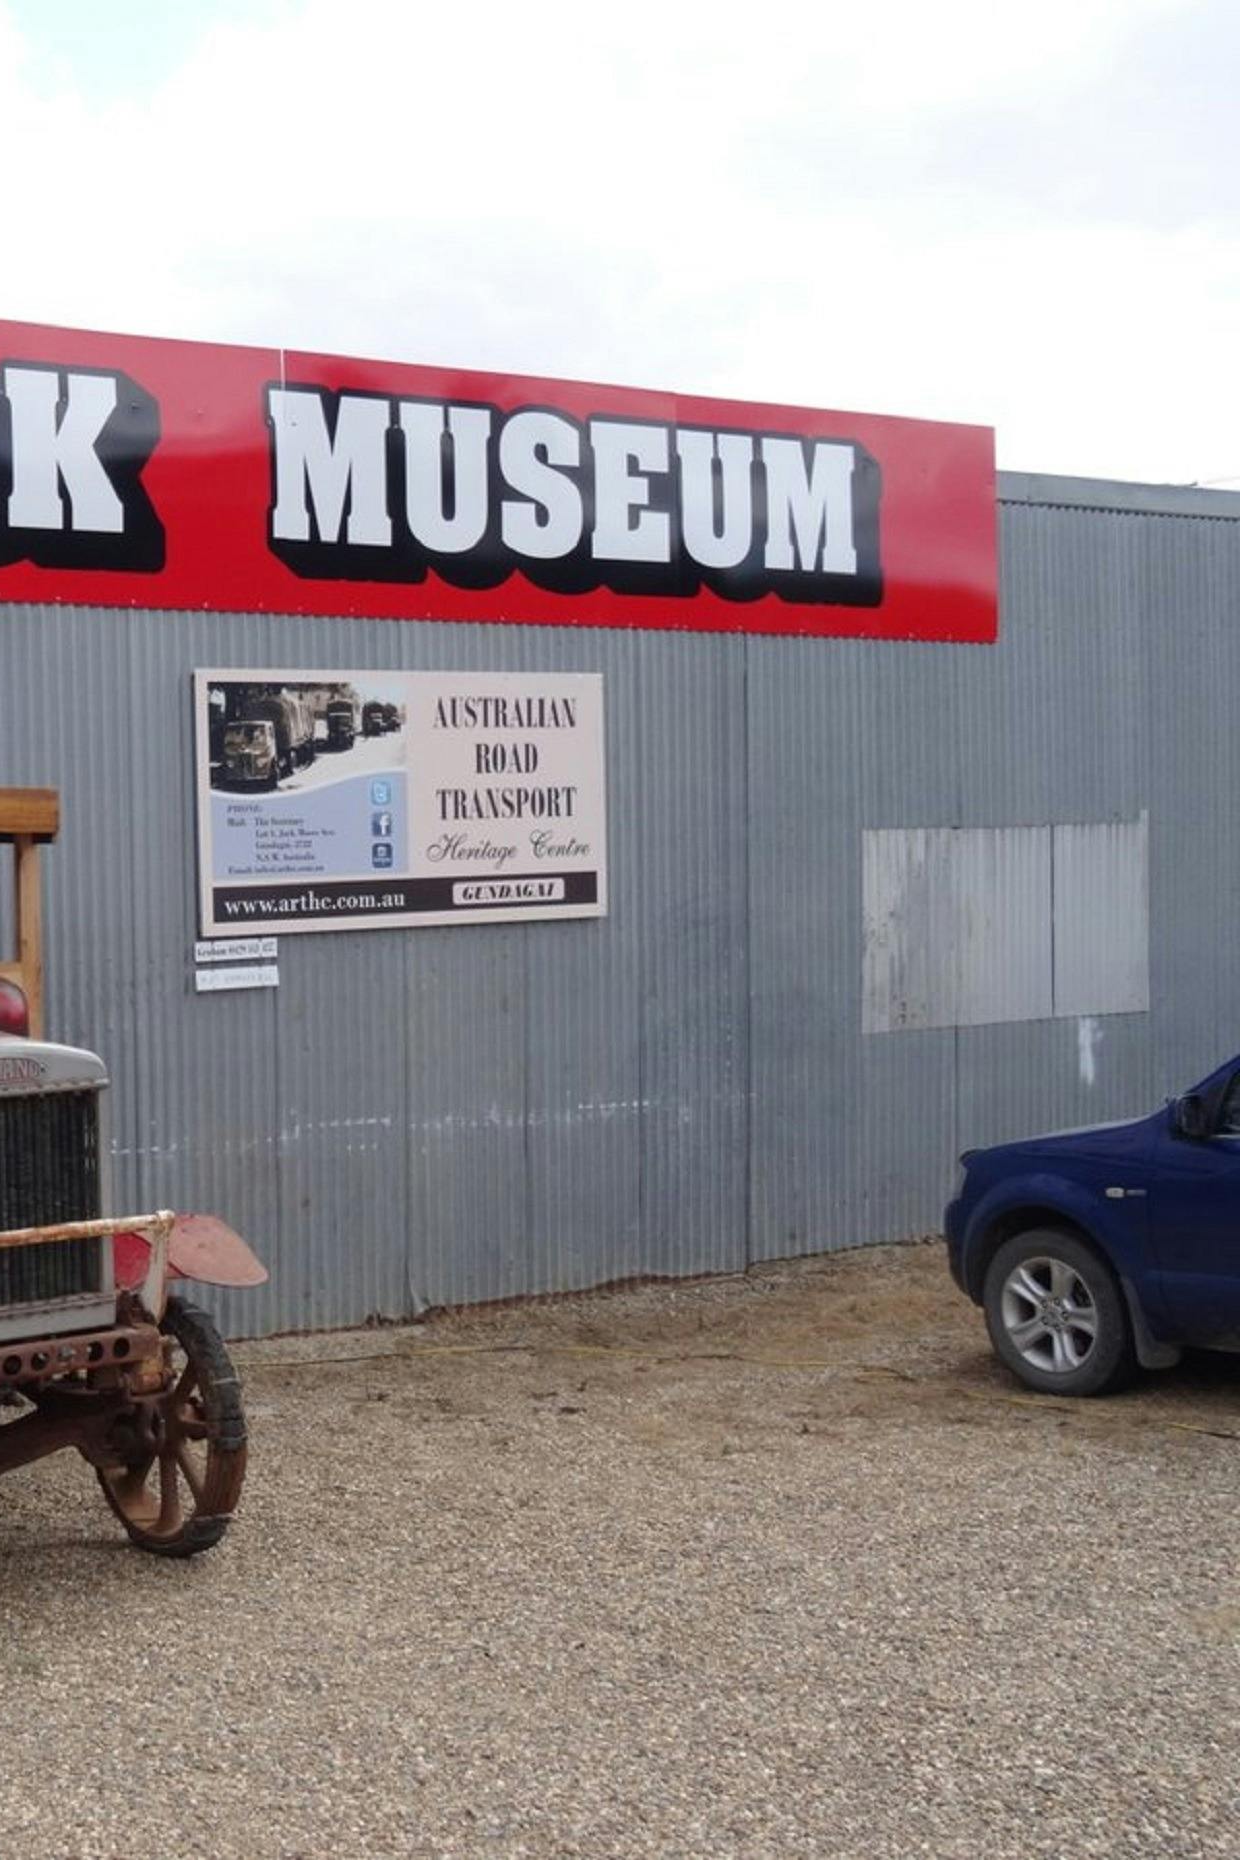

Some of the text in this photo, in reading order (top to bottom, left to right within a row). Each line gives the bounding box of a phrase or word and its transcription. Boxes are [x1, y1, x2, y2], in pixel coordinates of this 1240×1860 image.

[269, 388, 857, 576] MUSEUM
[433, 696, 577, 728] AUSTRALIAN
[475, 742, 538, 774] ROAD
[435, 787, 578, 820] TRANSPORT
[426, 829, 591, 869] Heritage Centre
[224, 882, 555, 915] www.arthc.com.au GUNDAGAI
